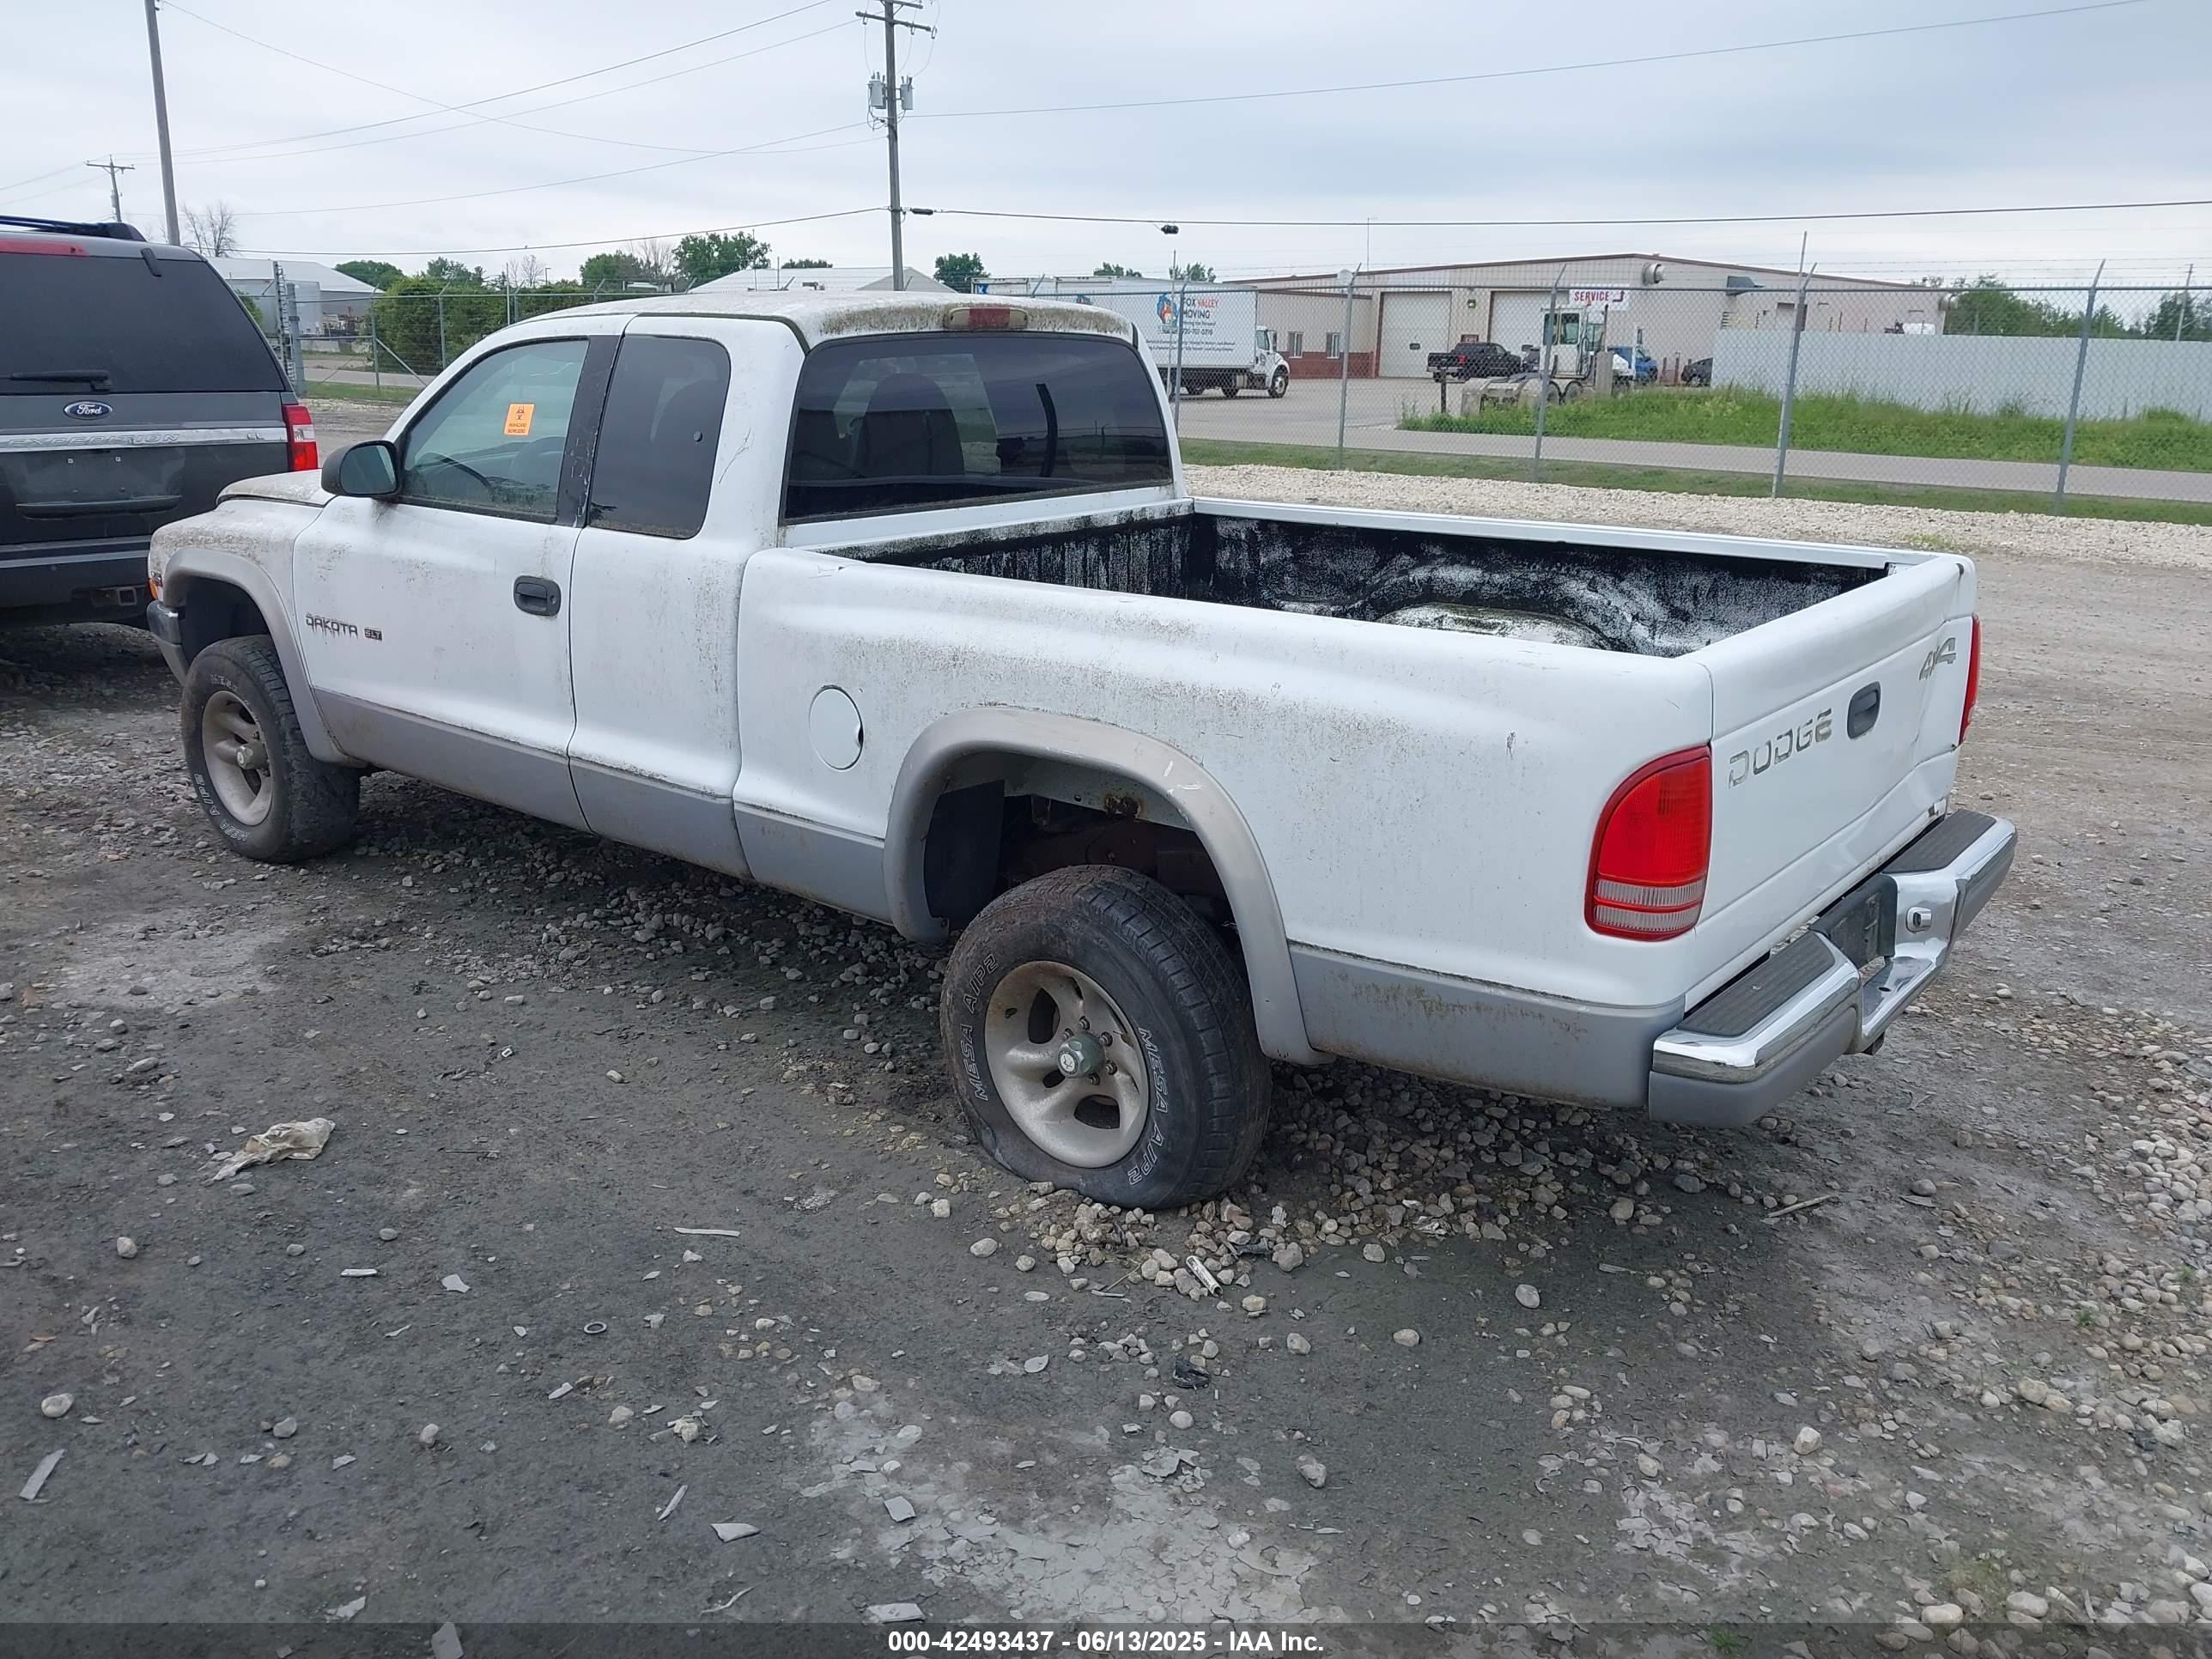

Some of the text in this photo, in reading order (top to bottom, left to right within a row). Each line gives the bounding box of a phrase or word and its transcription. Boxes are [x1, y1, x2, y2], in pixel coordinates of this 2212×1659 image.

[1182, 297, 1218, 307] FOX VALLEY
[1574, 290, 1609, 301] SERVICE
[76, 404, 102, 416] Ford
[8, 433, 179, 447] EXPEDITION
[306, 614, 382, 641] DAKOTA SLT
[1728, 708, 1832, 790] DODGE
[960, 1024, 988, 1101] MESA
[1139, 1027, 1169, 1113] MESA
